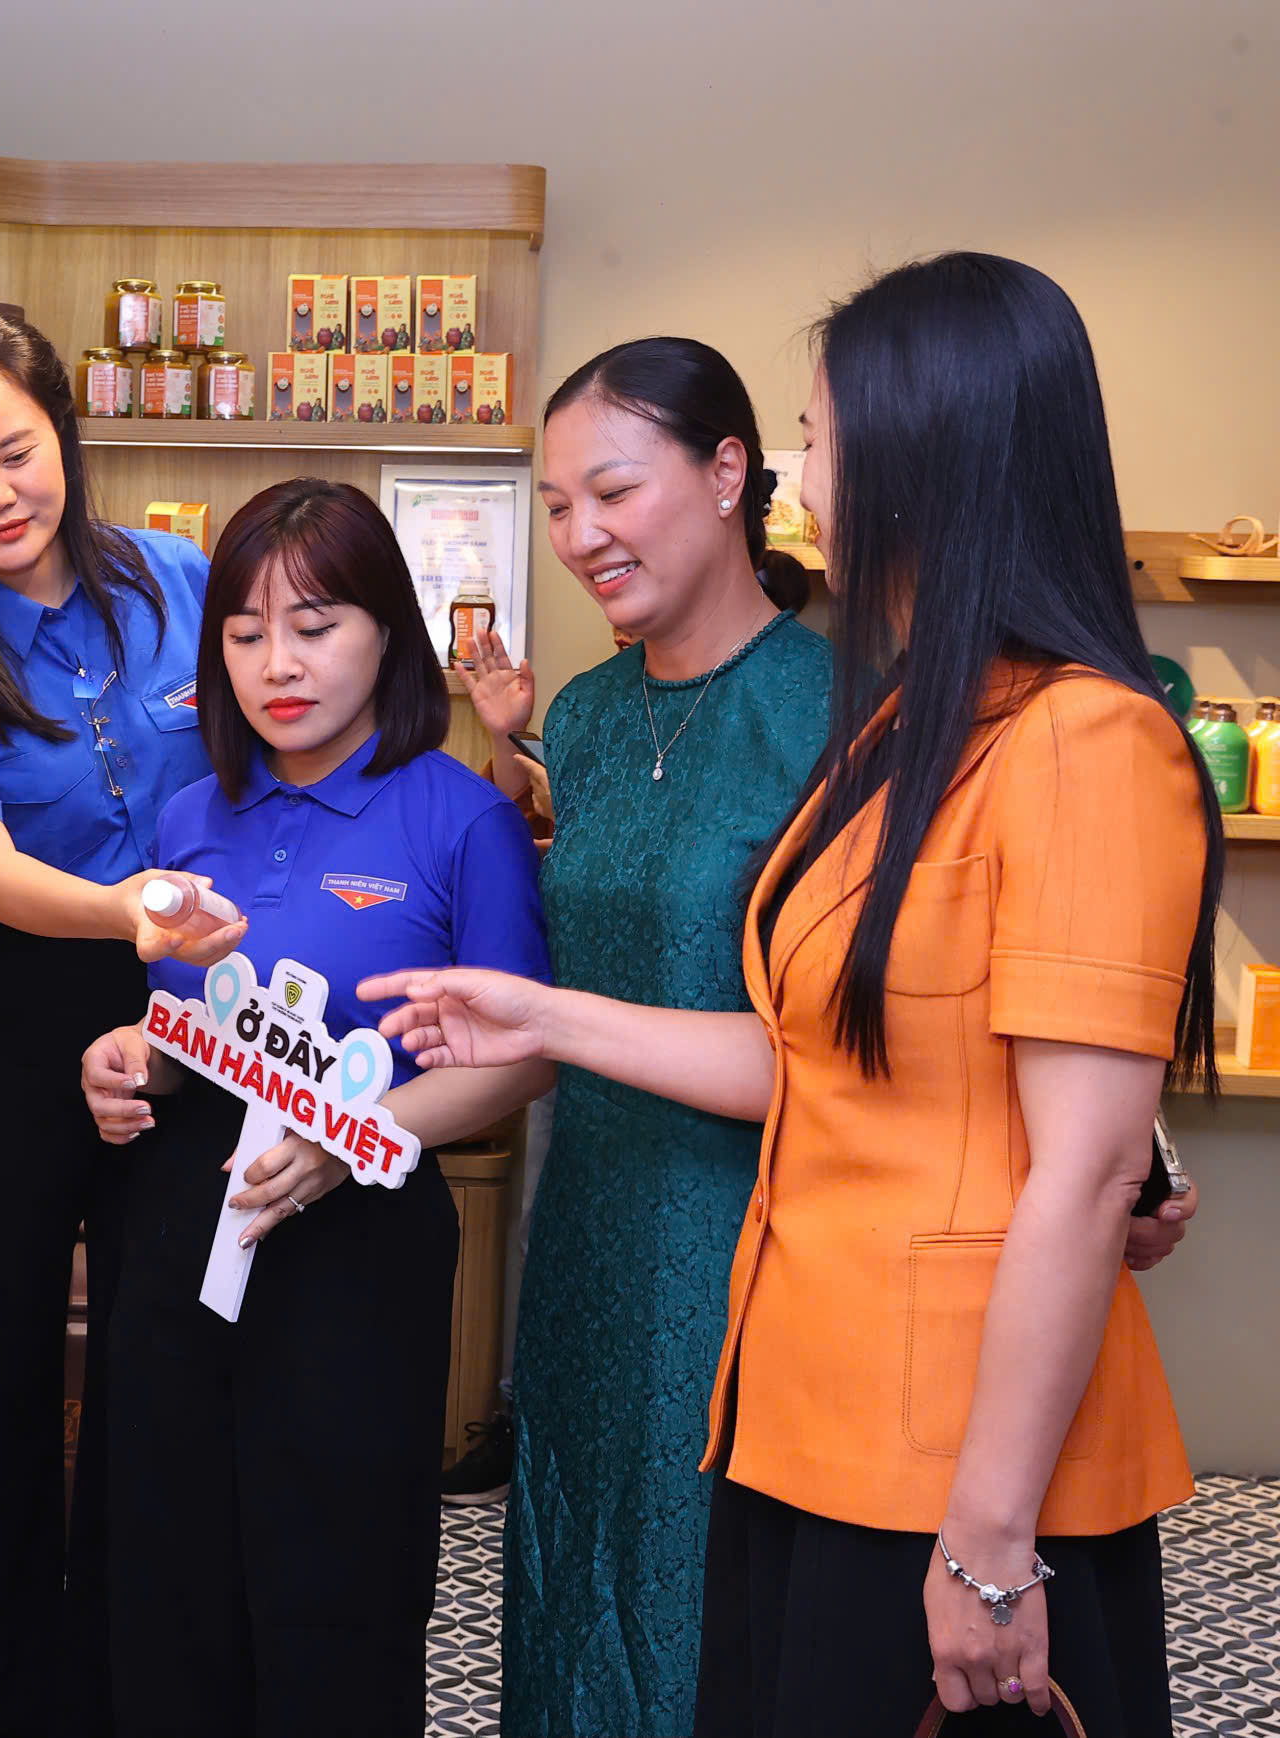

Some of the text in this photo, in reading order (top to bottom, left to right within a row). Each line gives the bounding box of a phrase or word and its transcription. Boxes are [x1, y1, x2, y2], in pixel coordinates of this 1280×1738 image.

[351, 880, 367, 888] NIÊN
[368, 882, 384, 891] VIỆT
[384, 886, 401, 894] NAM
[236, 999, 265, 1042] Ở
[264, 1030, 337, 1083] ĐÂY
[147, 1002, 404, 1173] BÁN HÀNG VIỆT
